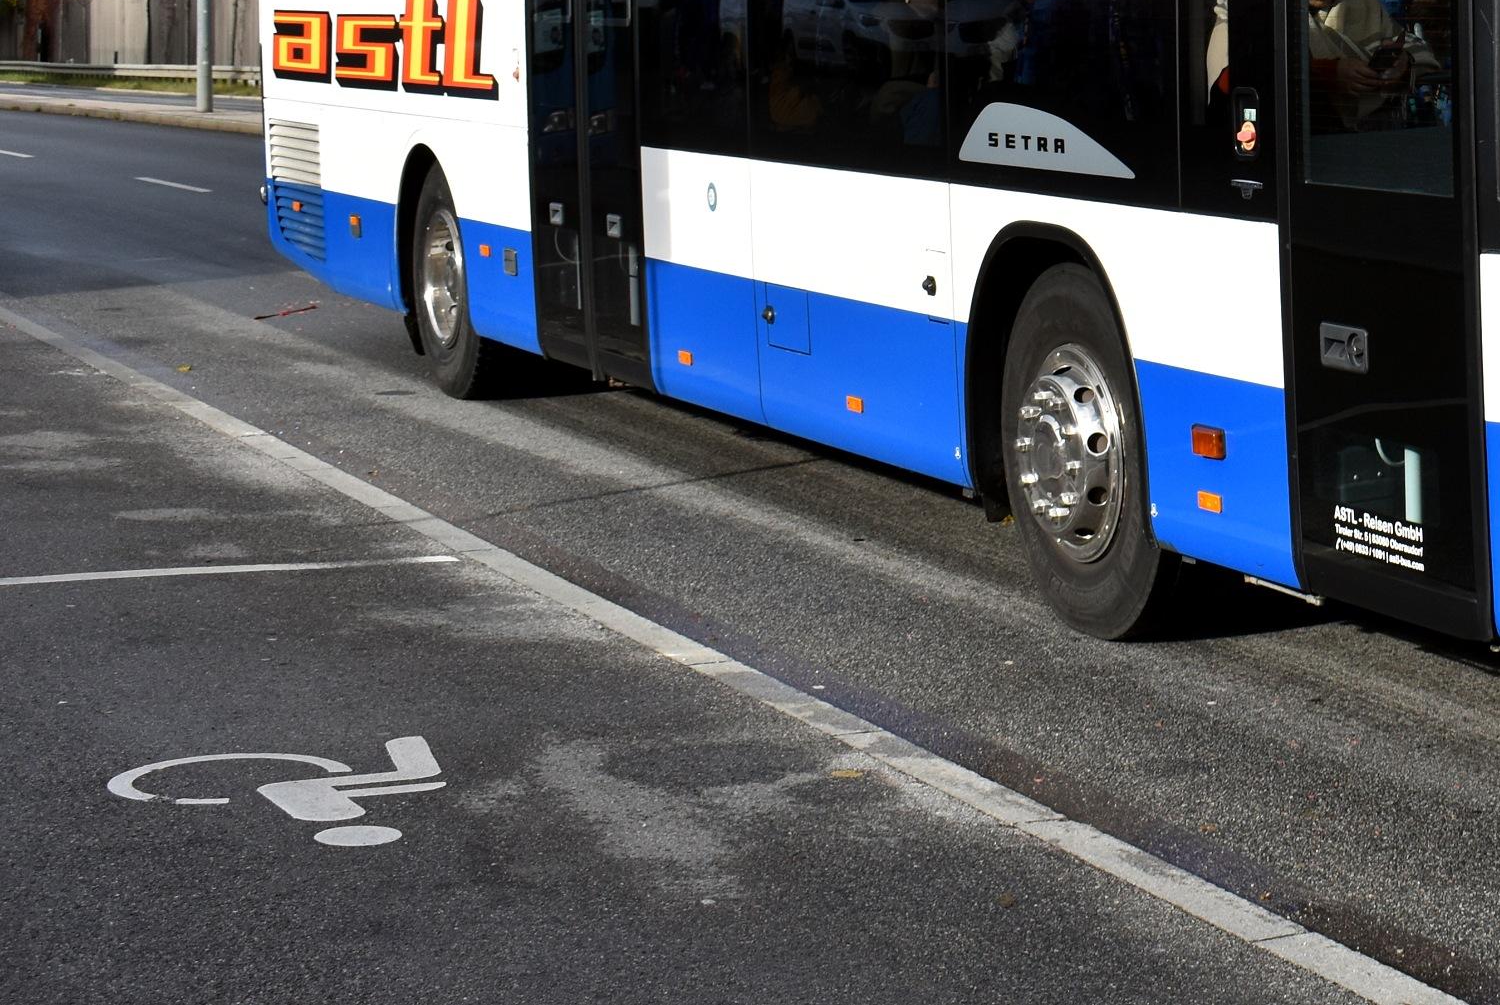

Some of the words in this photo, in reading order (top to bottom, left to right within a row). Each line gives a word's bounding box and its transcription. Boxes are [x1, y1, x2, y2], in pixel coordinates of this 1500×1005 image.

[988, 132, 1066, 154] SETRA
[1334, 505, 1358, 525] ASTL
[1363, 512, 1393, 535] Reisen
[1394, 521, 1423, 543] GmbH
